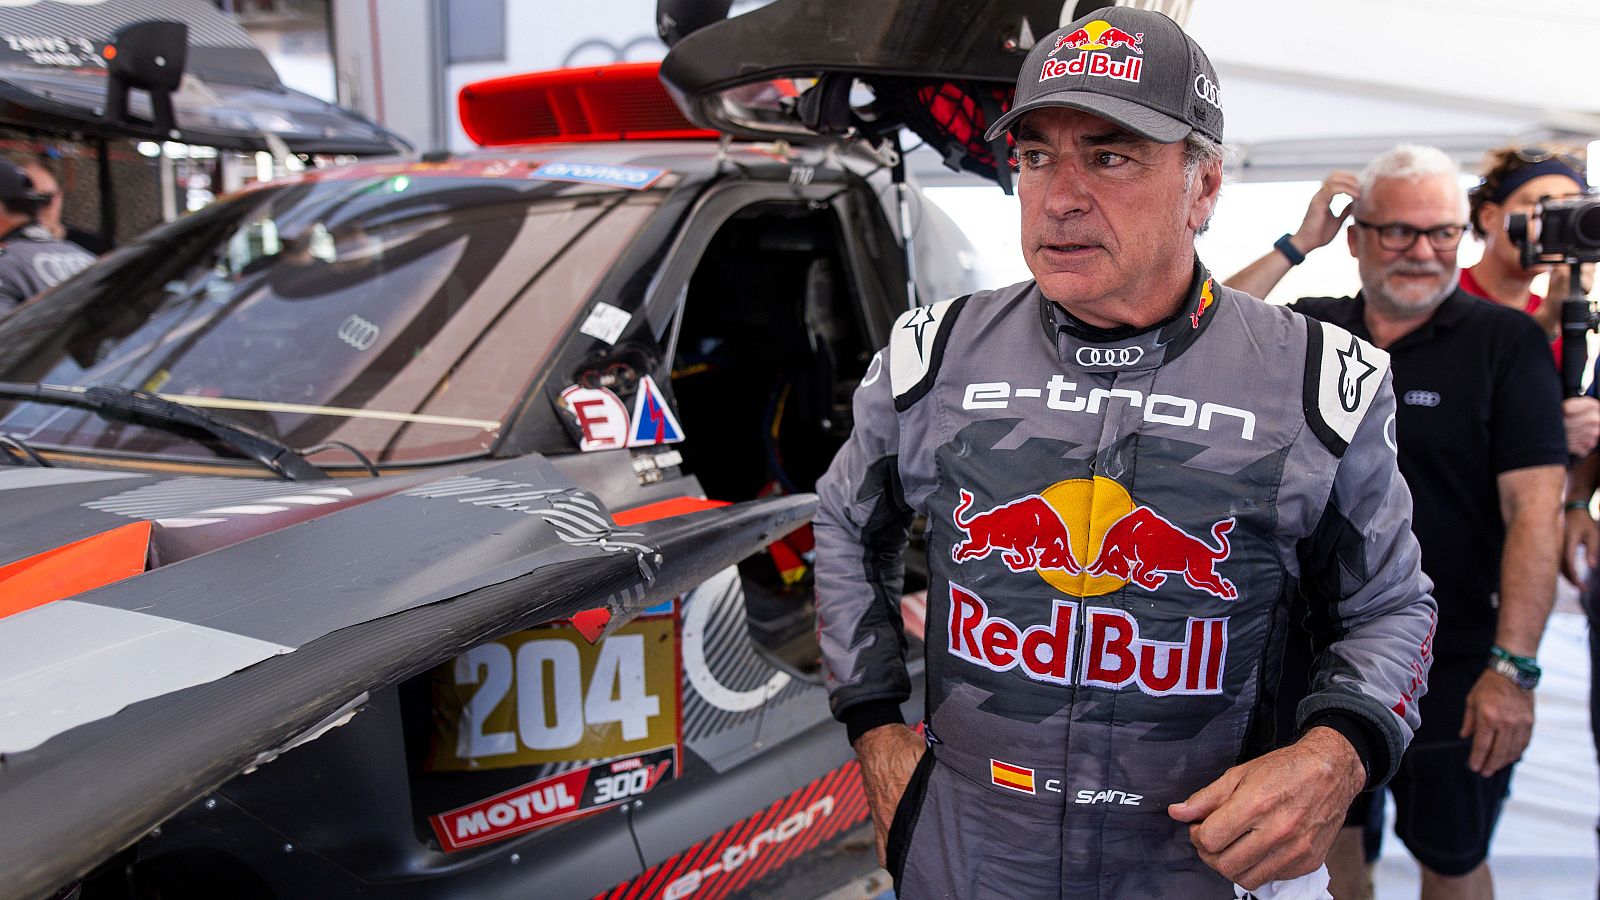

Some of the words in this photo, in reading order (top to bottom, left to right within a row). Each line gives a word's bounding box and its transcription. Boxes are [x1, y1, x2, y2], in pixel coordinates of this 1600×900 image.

[1040, 51, 1087, 81] Red
[1089, 53, 1141, 82] Bull
[573, 399, 615, 444] E
[962, 374, 1256, 441] e-tron
[950, 583, 1076, 683] Red
[1084, 608, 1228, 693] Bull
[454, 634, 660, 759] 204
[456, 783, 576, 839] MOTUL
[1044, 779, 1062, 793] C.
[1075, 789, 1144, 806] SAINZ
[663, 795, 835, 900] e-tron
